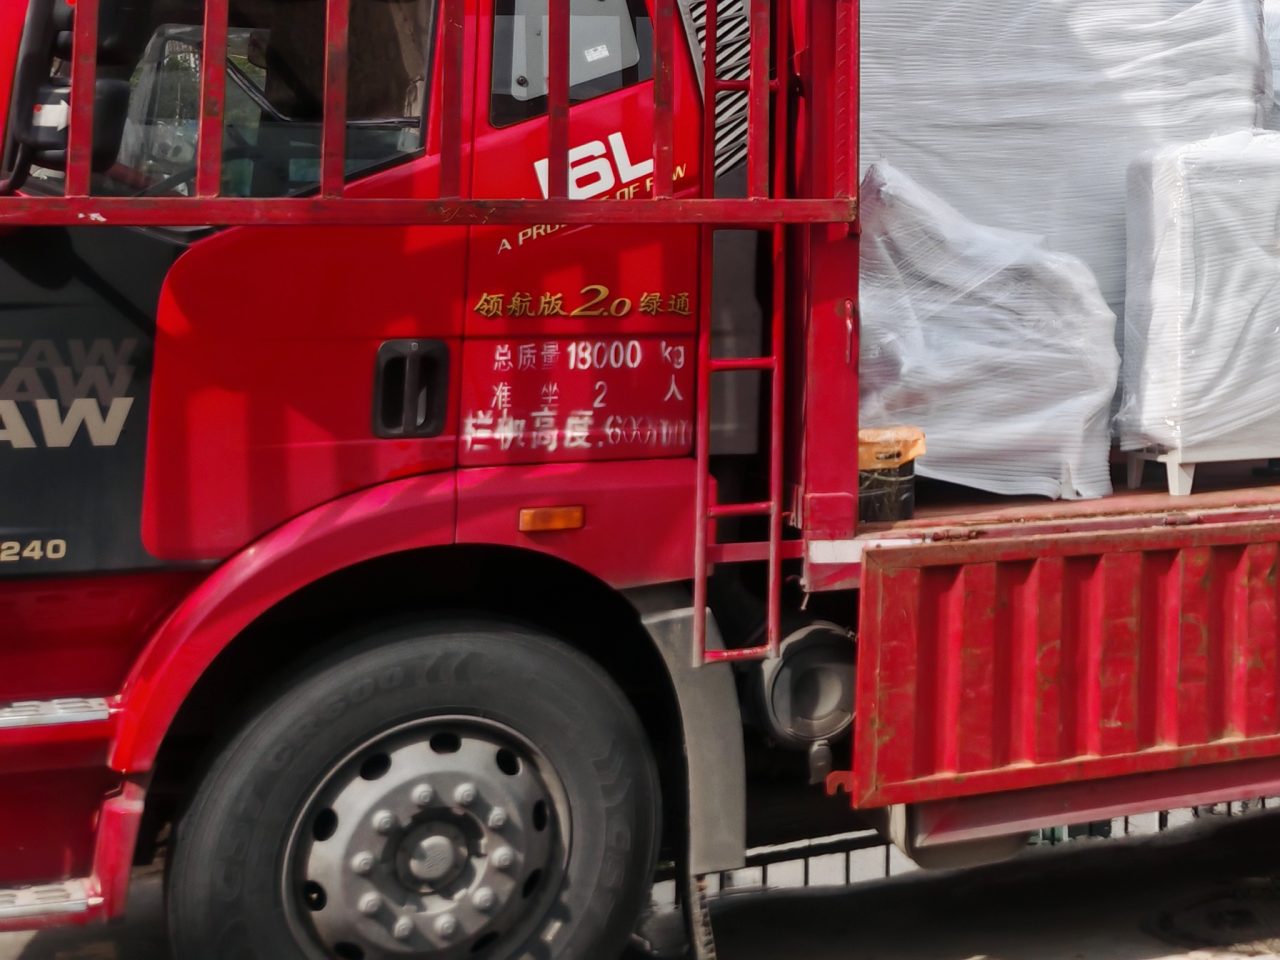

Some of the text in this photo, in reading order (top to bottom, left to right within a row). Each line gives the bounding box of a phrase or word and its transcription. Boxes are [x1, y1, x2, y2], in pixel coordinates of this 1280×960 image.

[645, 163, 687, 193] FW
[660, 340, 685, 369] kg
[592, 380, 608, 408] 2
[663, 373, 684, 401] 人
[0, 538, 67, 562] 240
